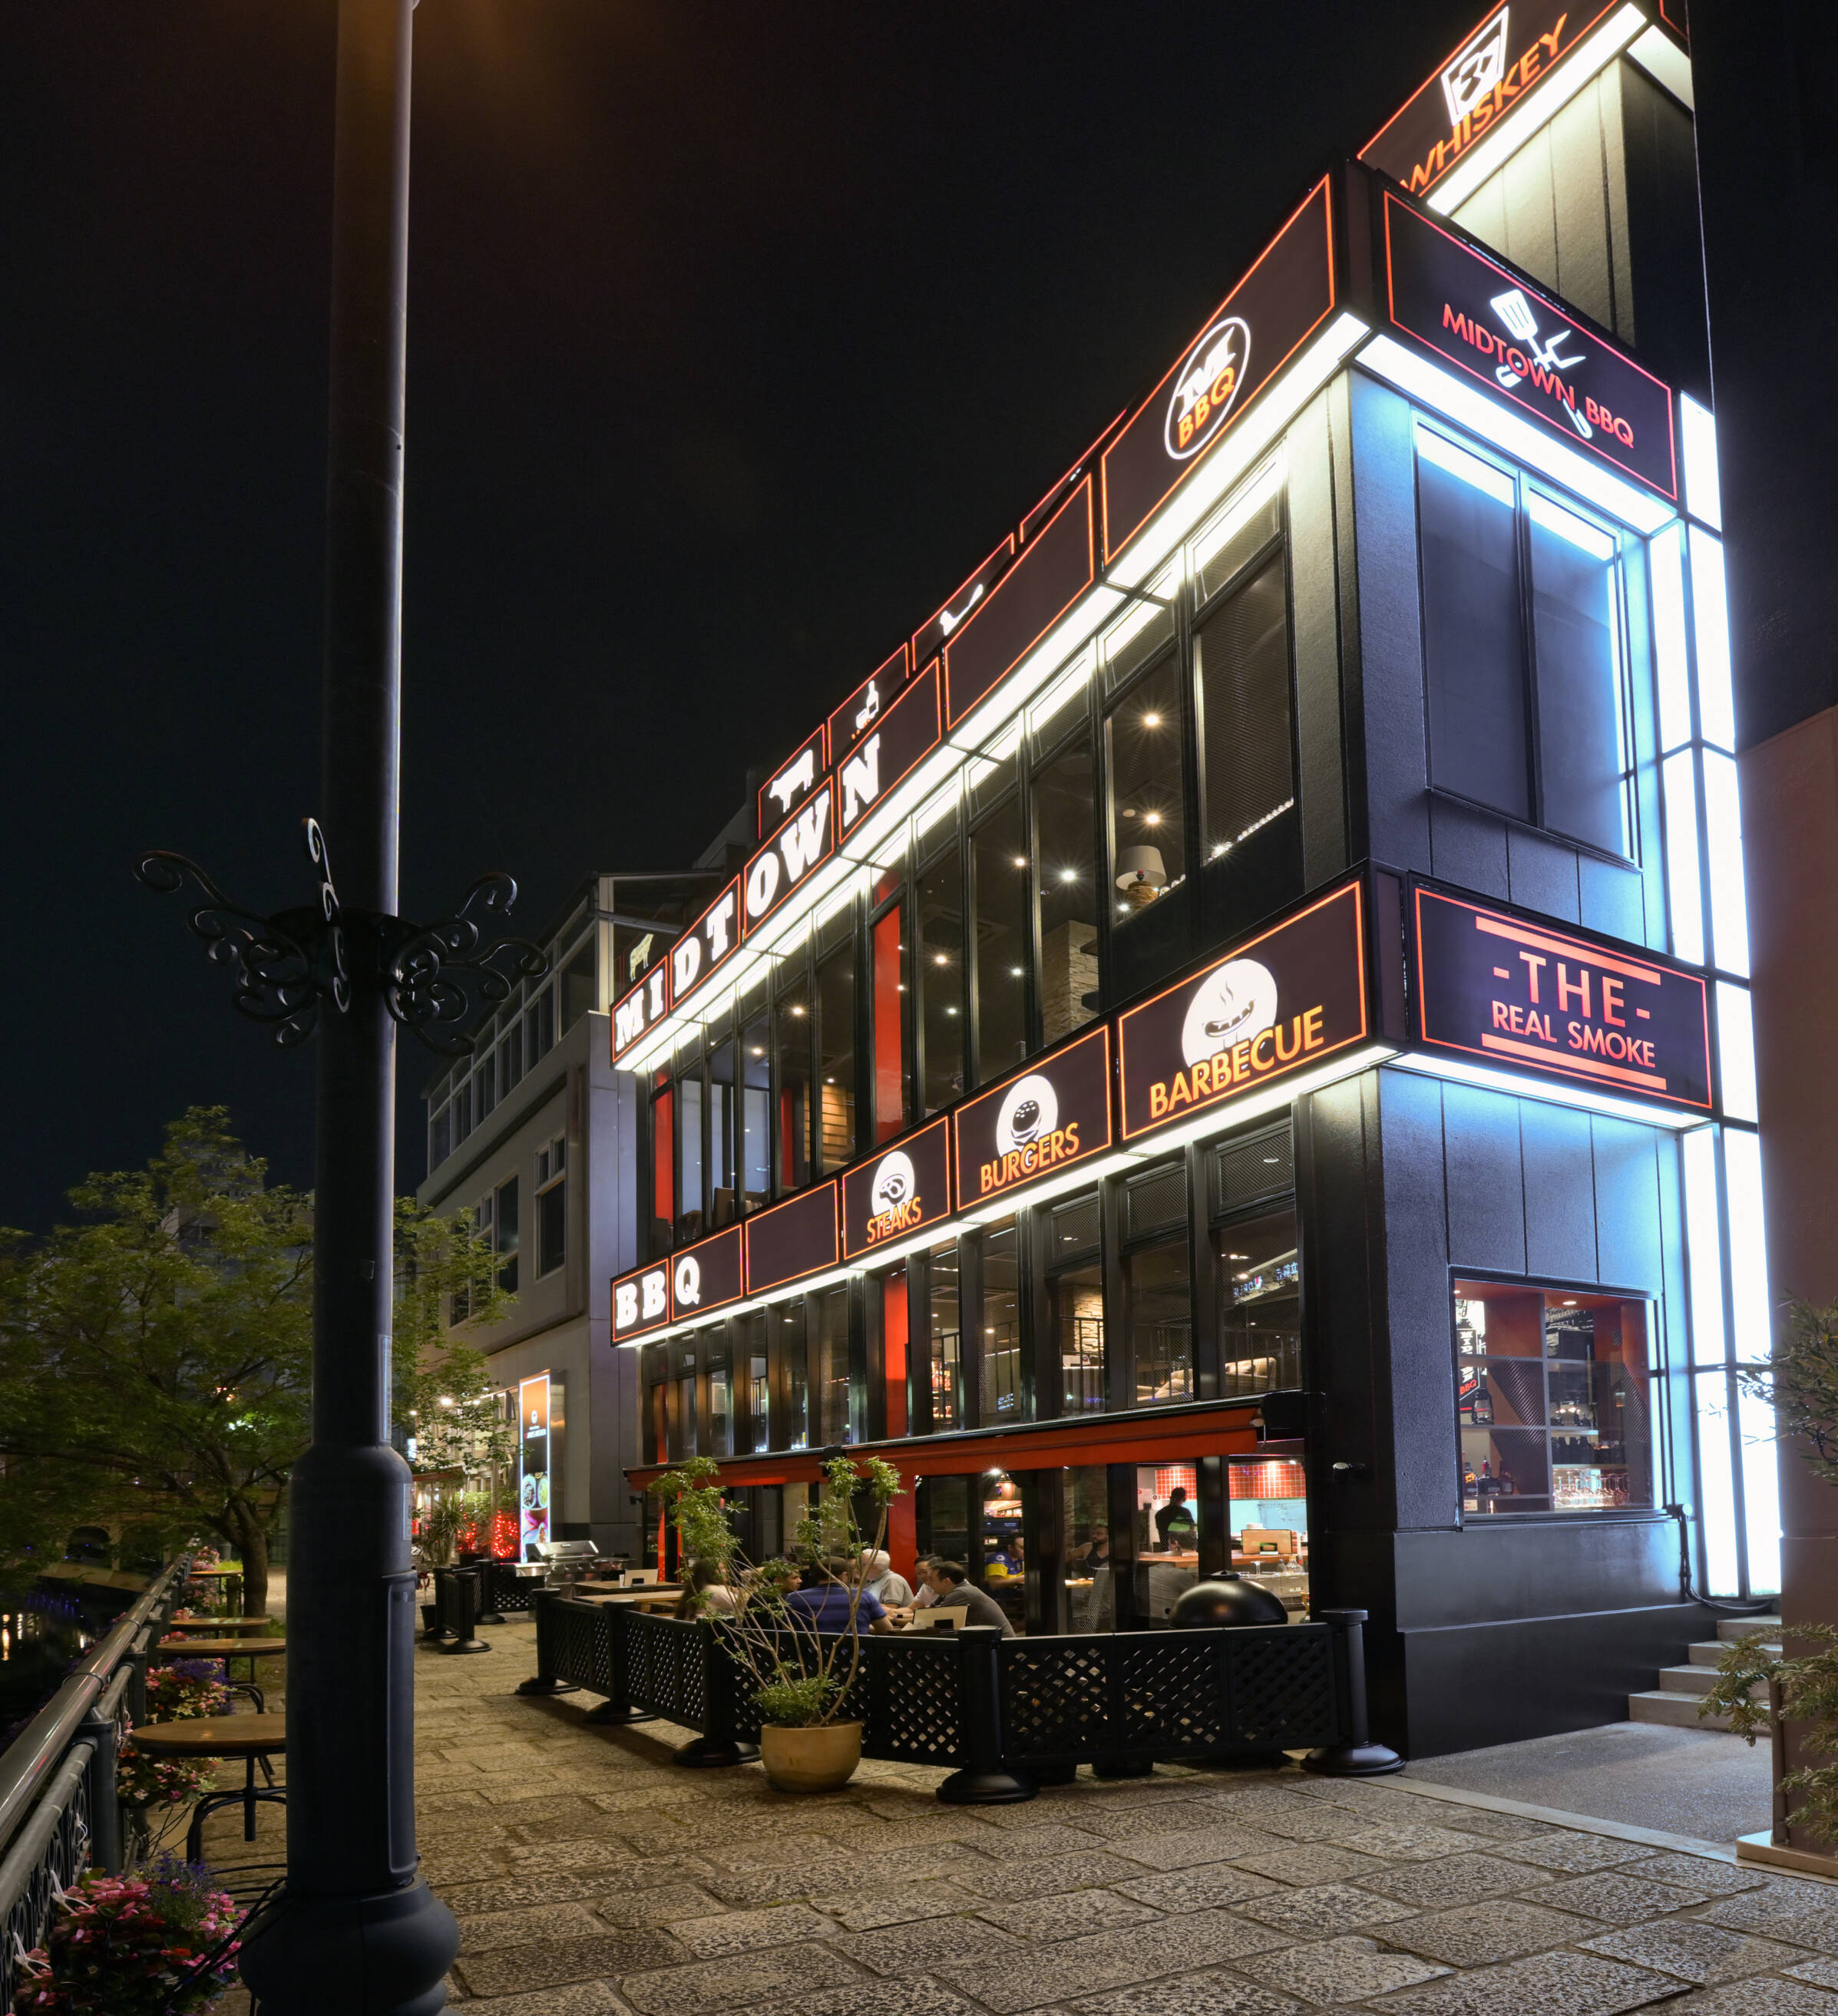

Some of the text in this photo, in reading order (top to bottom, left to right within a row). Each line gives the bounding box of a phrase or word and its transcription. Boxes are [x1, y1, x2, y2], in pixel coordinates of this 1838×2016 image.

[1400, 13, 1567, 192] WHISKEY
[1177, 326, 1236, 422] M
[1179, 367, 1235, 448] BBQ
[1443, 304, 1635, 448] MIDTOWN BBQ
[615, 733, 880, 1052] MIDTOWN
[1149, 1006, 1324, 1119] BARBECUE
[1493, 1000, 1656, 1068] REAL SMOKE
[980, 1123, 1079, 1194] BURGERS
[867, 1196, 922, 1244] STEAKS
[616, 1256, 700, 1330] BBQ
[1459, 1379, 1476, 1395] BBQ
